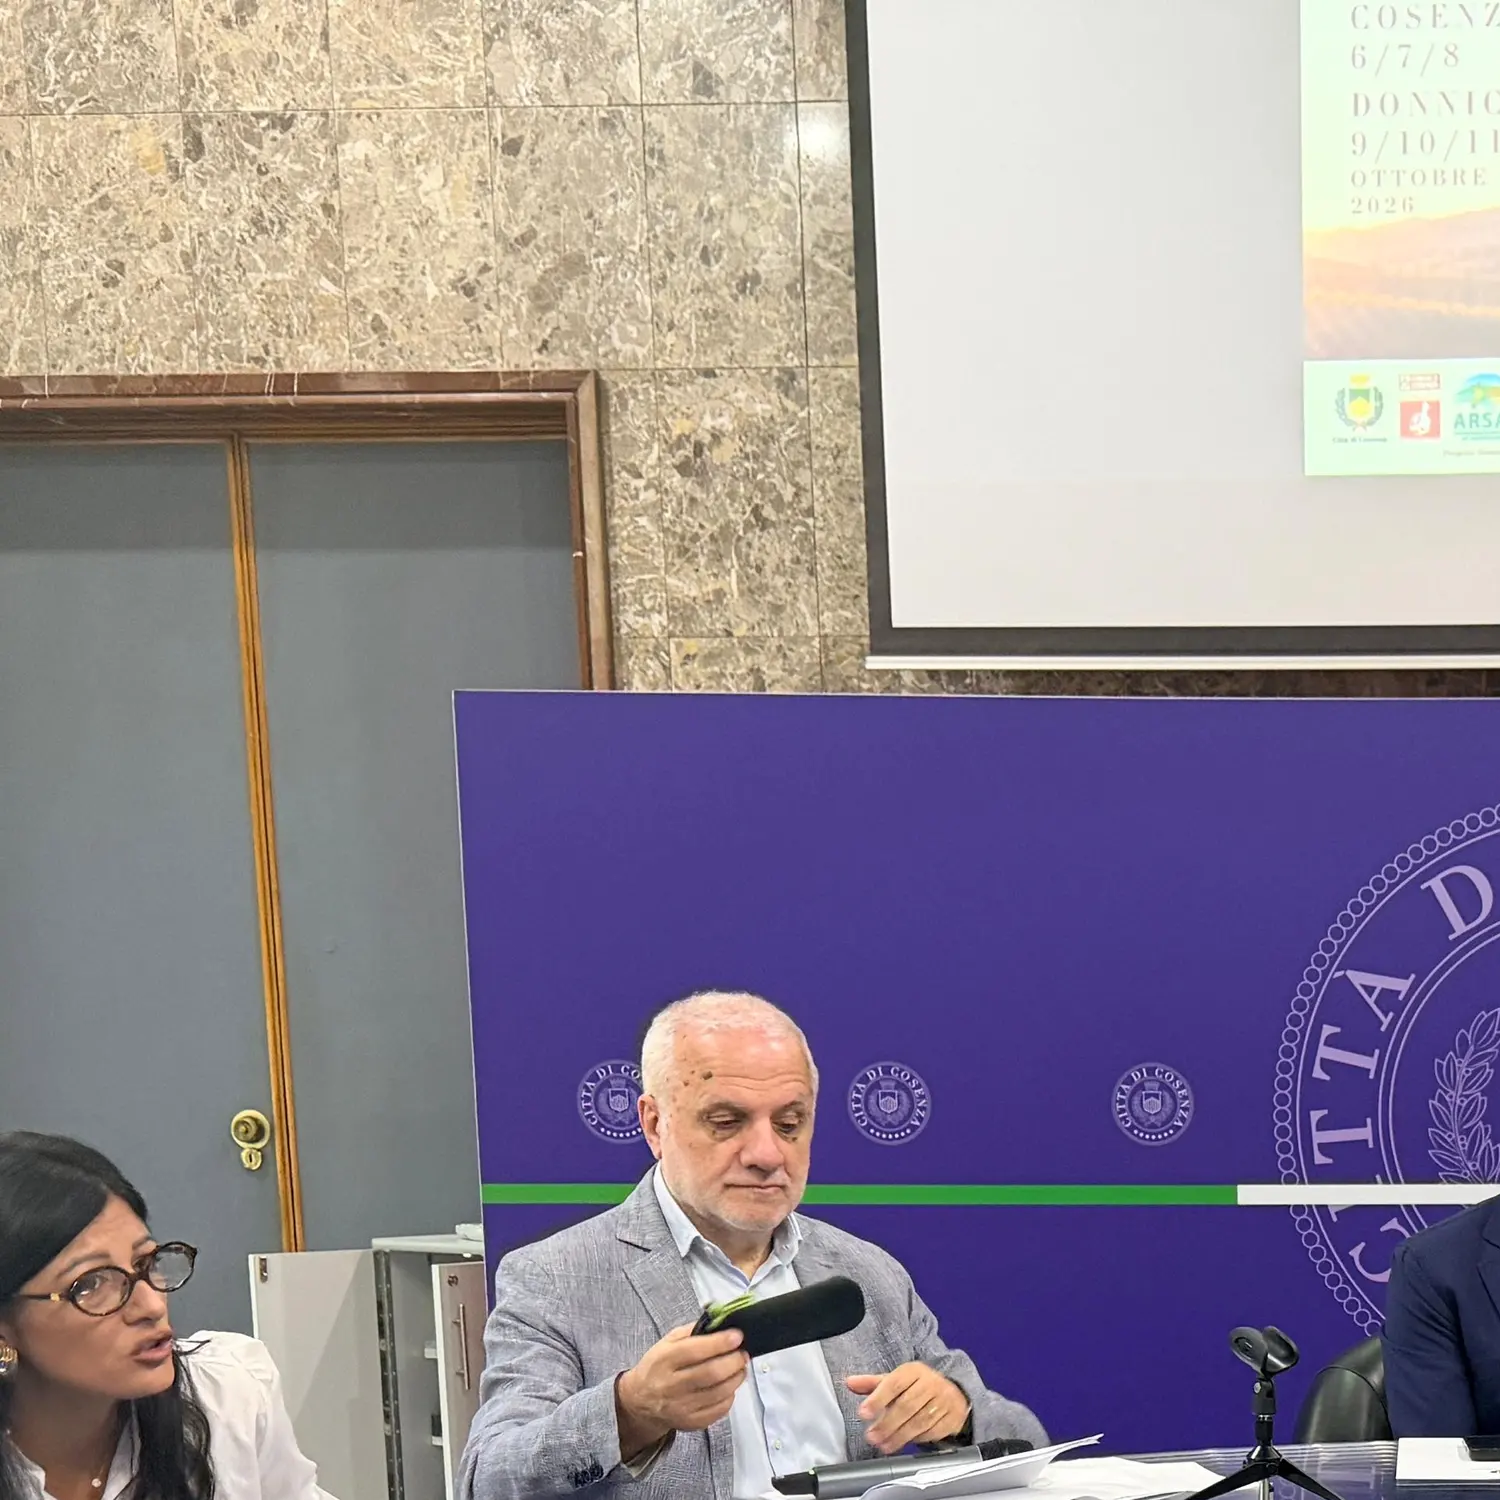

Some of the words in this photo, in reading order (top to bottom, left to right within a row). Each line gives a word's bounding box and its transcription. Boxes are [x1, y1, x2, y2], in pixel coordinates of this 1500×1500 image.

[1351, 42, 1460, 77] 6/7/8
[1350, 167, 1489, 188] OTTOBRE
[1350, 195, 1415, 214] 2026
[596, 1065, 613, 1079] DI
[866, 1066, 883, 1080] DI
[890, 1066, 928, 1126] COSENZA
[1131, 1067, 1148, 1081] DI
[1155, 1067, 1190, 1127] COSENZA
